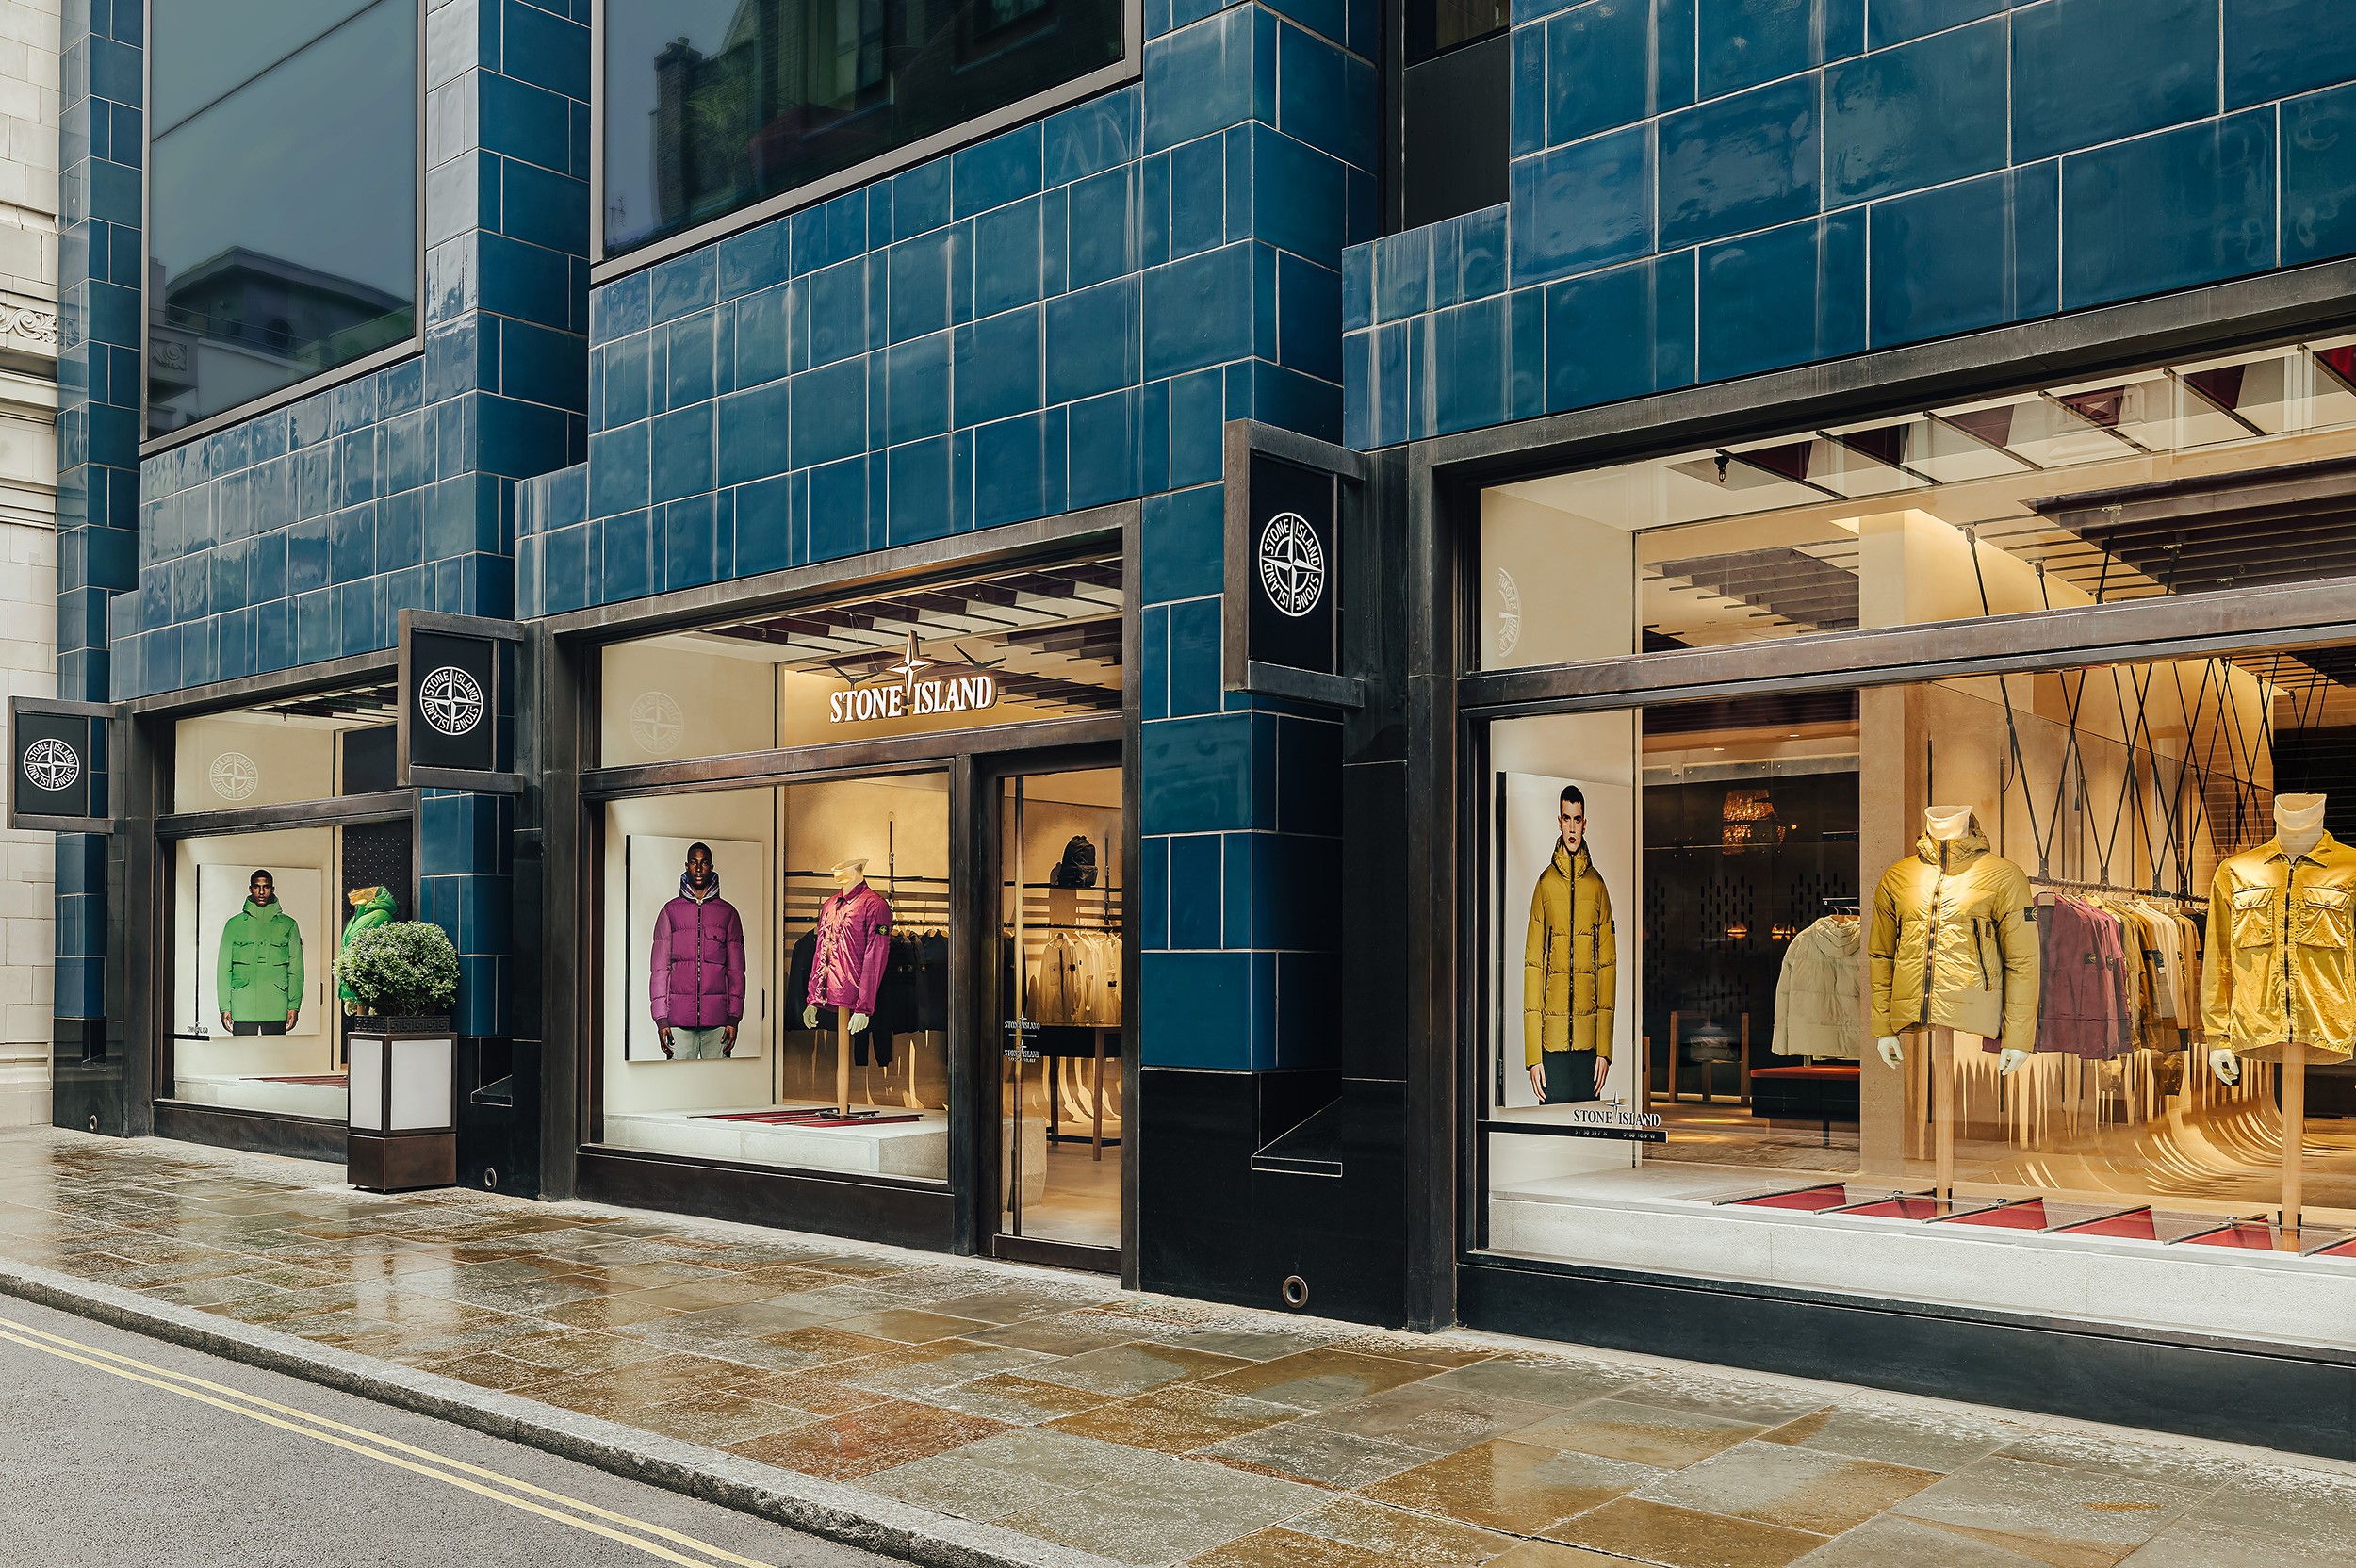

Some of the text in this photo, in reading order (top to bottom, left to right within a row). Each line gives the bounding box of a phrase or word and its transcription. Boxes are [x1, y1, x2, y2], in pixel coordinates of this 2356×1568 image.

[1264, 518, 1320, 611] STONE ISLAND STONE ISLAND
[424, 671, 480, 731] STONE ISLAND STONE ISLAND
[829, 676, 997, 723] STONE ISLAND
[27, 742, 76, 788] STONE ISLAND STONE ISLAND
[1573, 1109, 1661, 1127] STONE ISLAND
